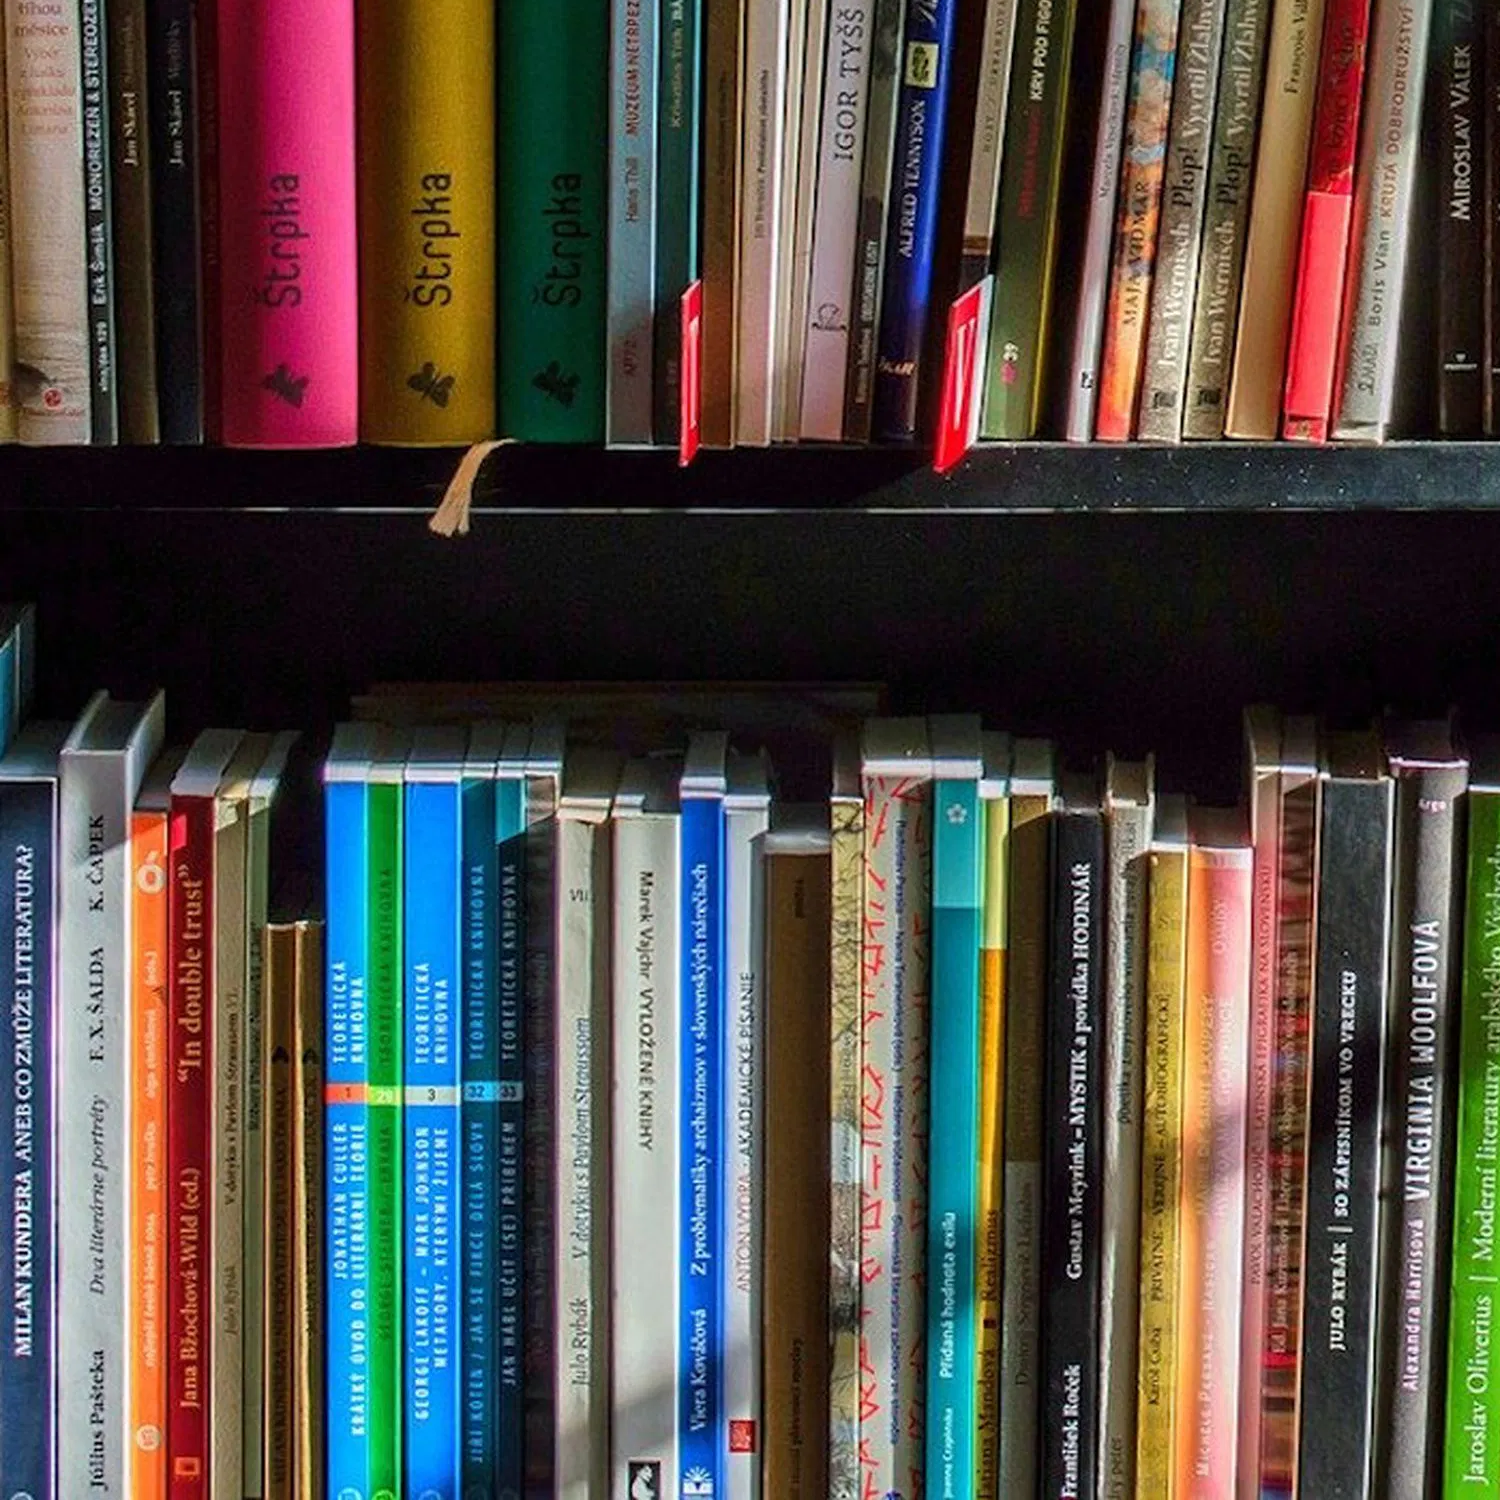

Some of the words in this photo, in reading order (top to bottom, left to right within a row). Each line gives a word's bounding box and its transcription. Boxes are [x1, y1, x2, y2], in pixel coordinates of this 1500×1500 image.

[833, 7, 864, 79] TYŠŠ
[1449, 45, 1473, 107] VÁLEK
[833, 89, 858, 162] IGOR
[1227, 67, 1255, 136] Vyvrtil
[902, 100, 926, 188] TENNYSON
[1217, 144, 1248, 206] Plop!
[1451, 114, 1472, 220] MIROSLAV
[253, 174, 309, 307] Štrpka
[402, 174, 459, 307] Štrpka
[529, 174, 592, 307] Štrpka
[898, 193, 917, 258] ALFRED
[1211, 222, 1239, 320] Wernisch
[1206, 322, 1226, 366] Ivan
[85, 815, 105, 885] ČAPEK
[15, 846, 34, 985] LITERATURA?
[89, 891, 105, 912] K.
[86, 947, 105, 1015] ŠALDA
[178, 948, 202, 1033] double
[1409, 921, 1440, 1063] WOOLFOVÁ
[13, 990, 34, 1065] ZMŮŽE
[89, 1020, 105, 1040] X.
[89, 1046, 105, 1062] F.
[16, 1068, 34, 1102] CO
[15, 1105, 32, 1162] ANEB
[88, 1095, 109, 1174] portréty
[1406, 1075, 1434, 1200] VIRGINIA
[13, 1170, 33, 1277] KUNDERA
[87, 1176, 106, 1253] literárne
[178, 1168, 201, 1210] (ed.)
[88, 1258, 105, 1295] Dva
[177, 1215, 201, 1360] Bžochová-Wild
[13, 1283, 33, 1356] MILAN
[86, 1350, 105, 1425] Pašteka
[179, 1364, 200, 1409] Jana
[88, 1431, 107, 1490] Július
